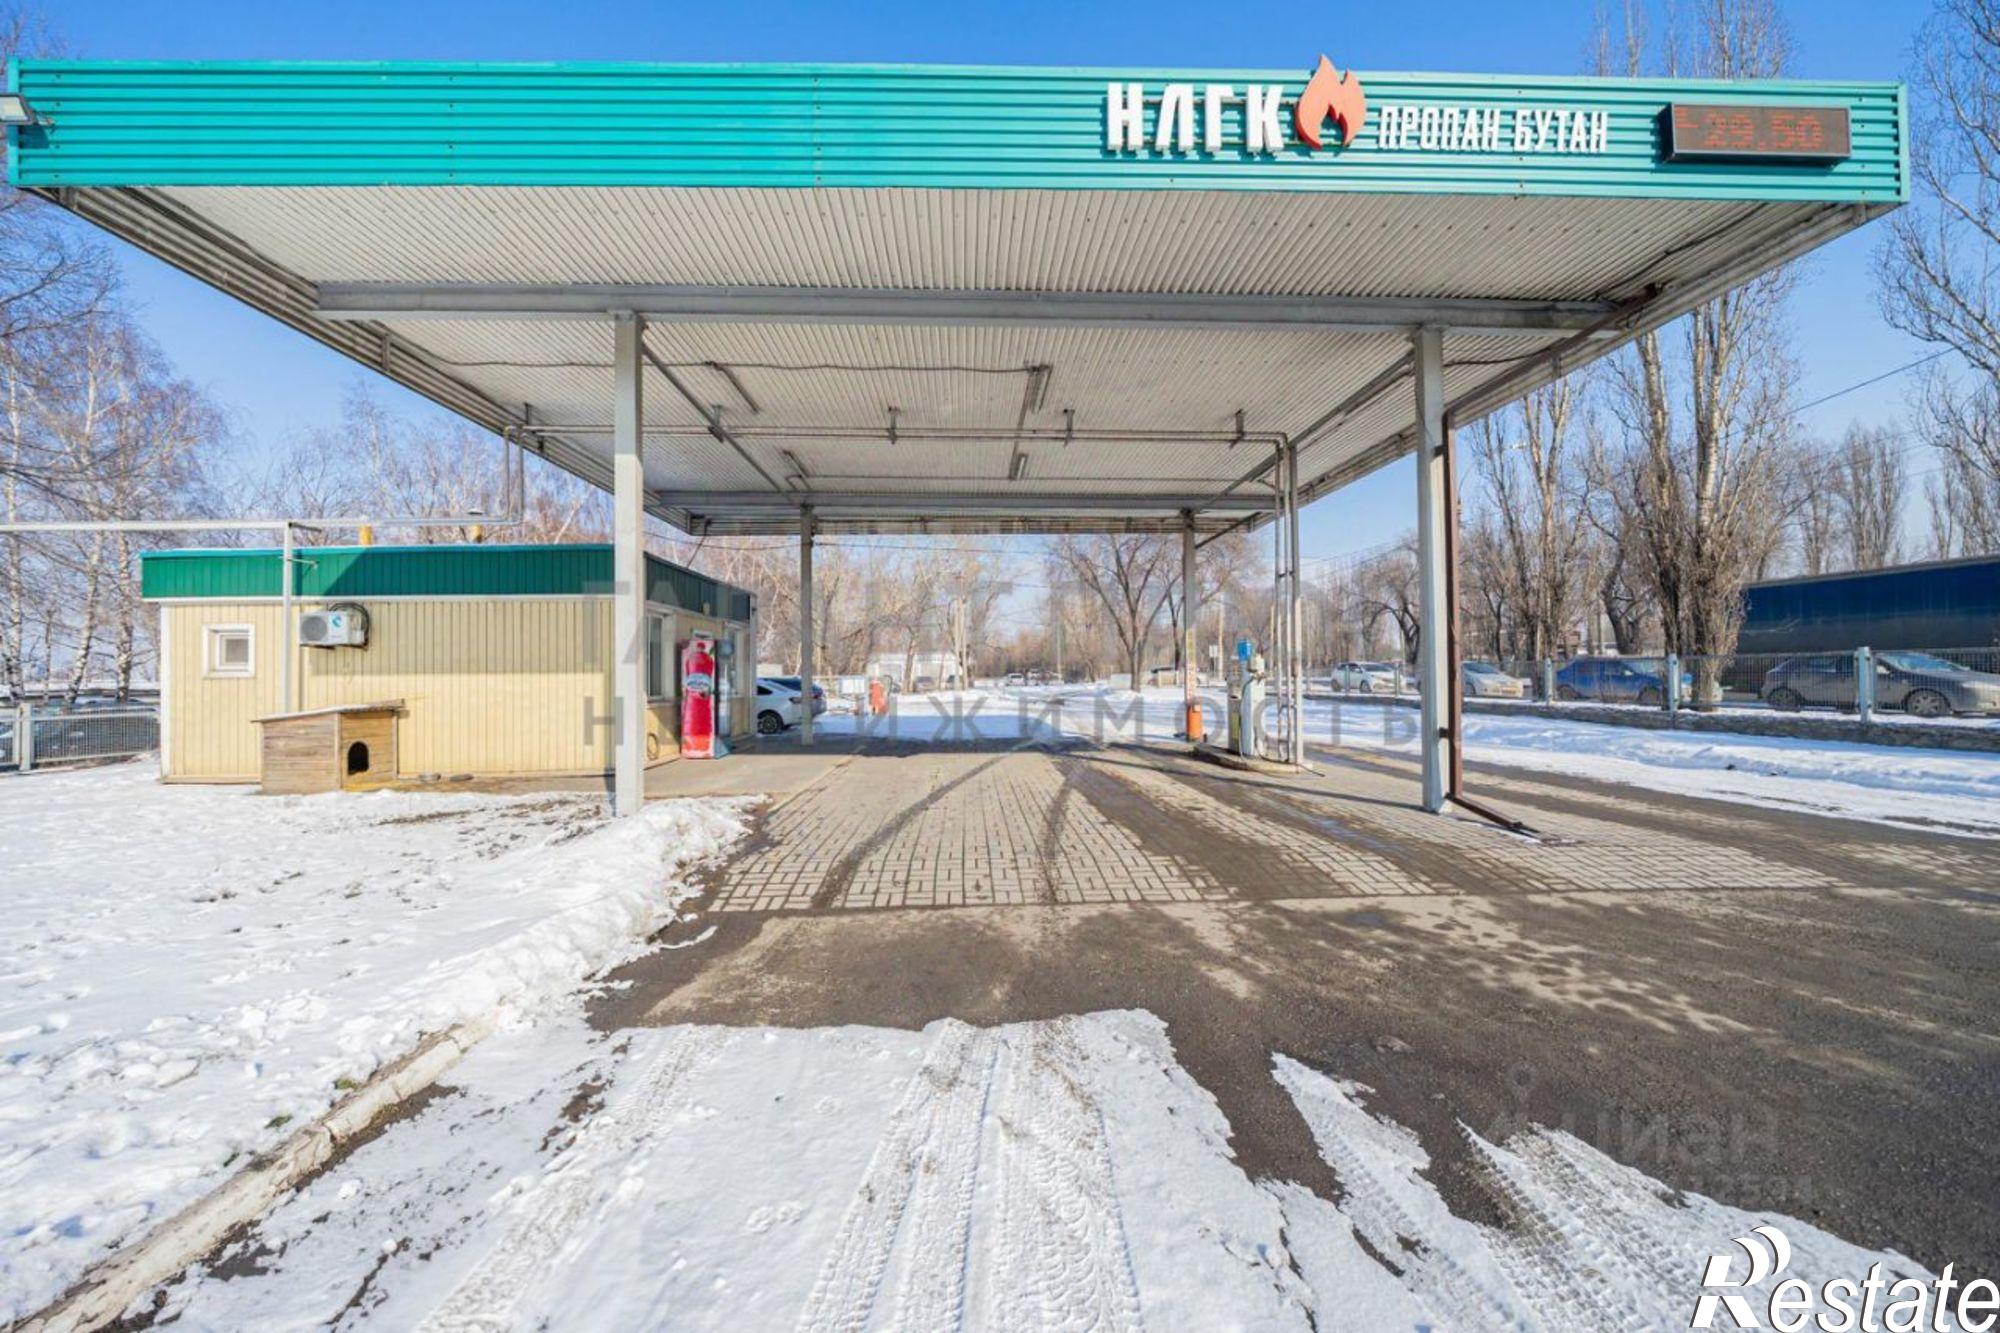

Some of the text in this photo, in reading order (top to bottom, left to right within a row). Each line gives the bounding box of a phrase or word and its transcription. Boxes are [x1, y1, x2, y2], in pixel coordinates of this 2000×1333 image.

[1107, 83, 1285, 151] НЛГК
[1378, 105, 1609, 153] ПРОПАН БУТАН
